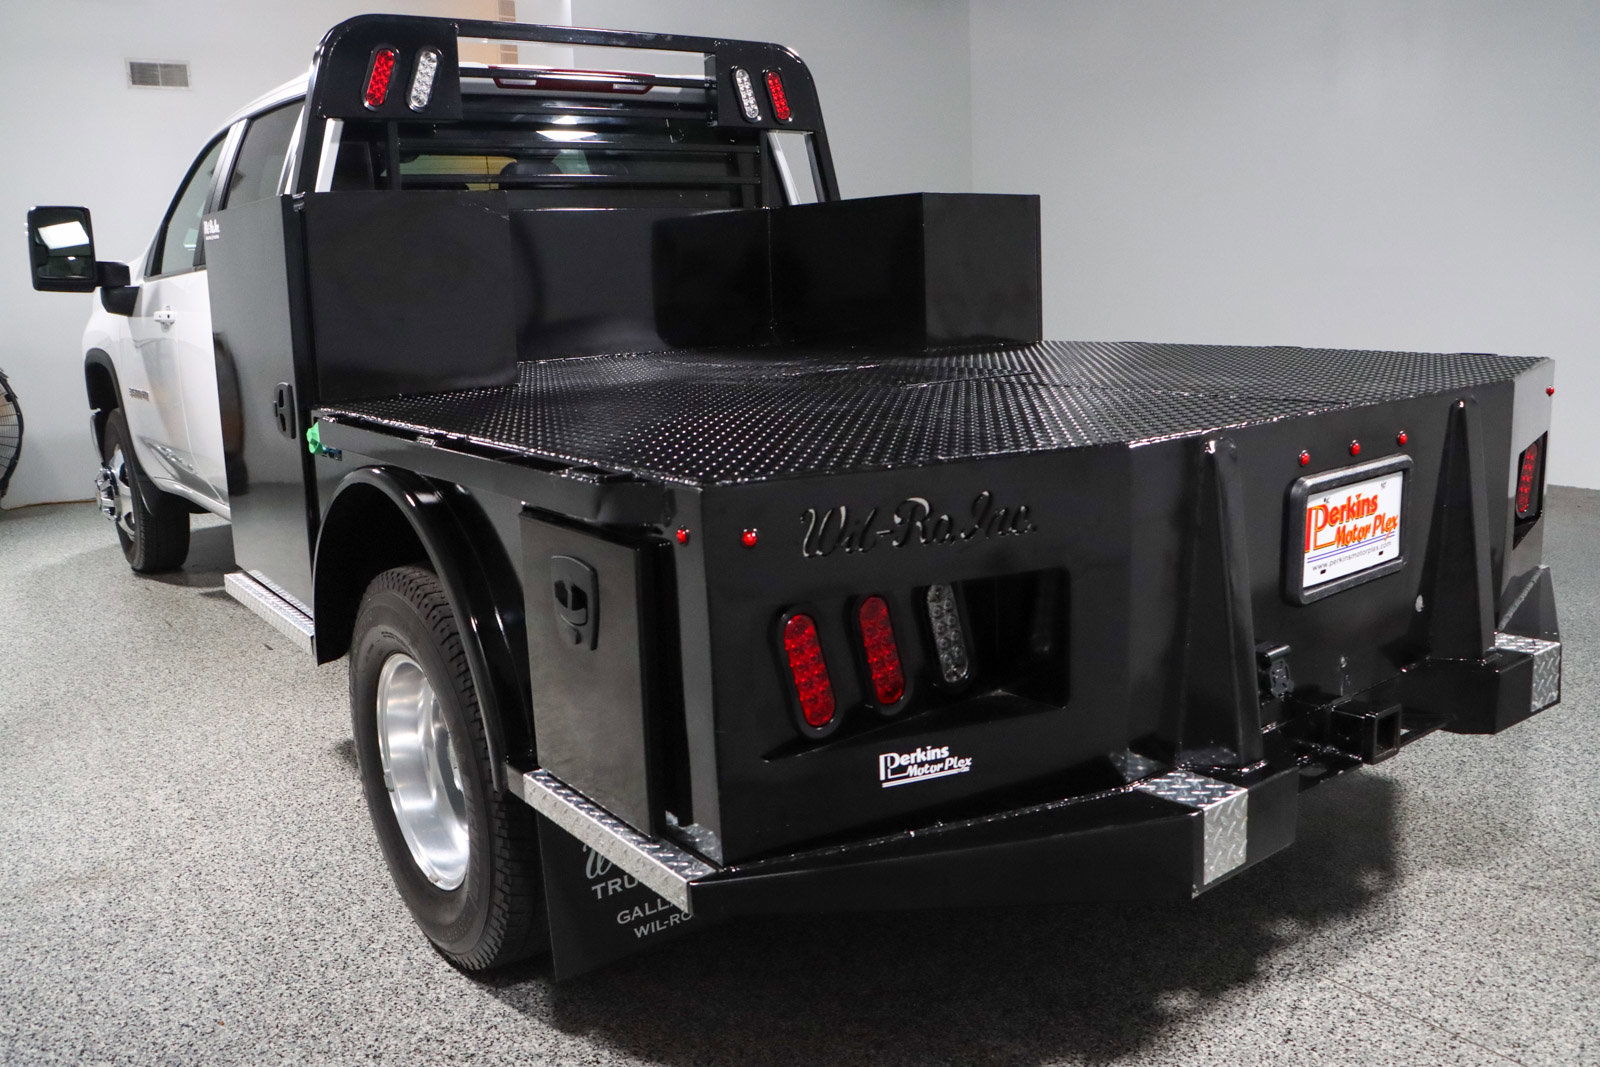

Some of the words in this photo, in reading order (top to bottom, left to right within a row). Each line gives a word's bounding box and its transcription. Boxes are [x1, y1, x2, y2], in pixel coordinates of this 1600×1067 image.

[1305, 493, 1378, 553] Perkins
[1335, 524, 1371, 547] Motor
[1312, 541, 1391, 570] www.perkinsmotorplex.com
[879, 746, 949, 780] Perkins
[907, 763, 943, 777] Motor
[944, 756, 972, 770] Plex
[591, 874, 639, 900] TRU
[616, 898, 674, 925] GALL
